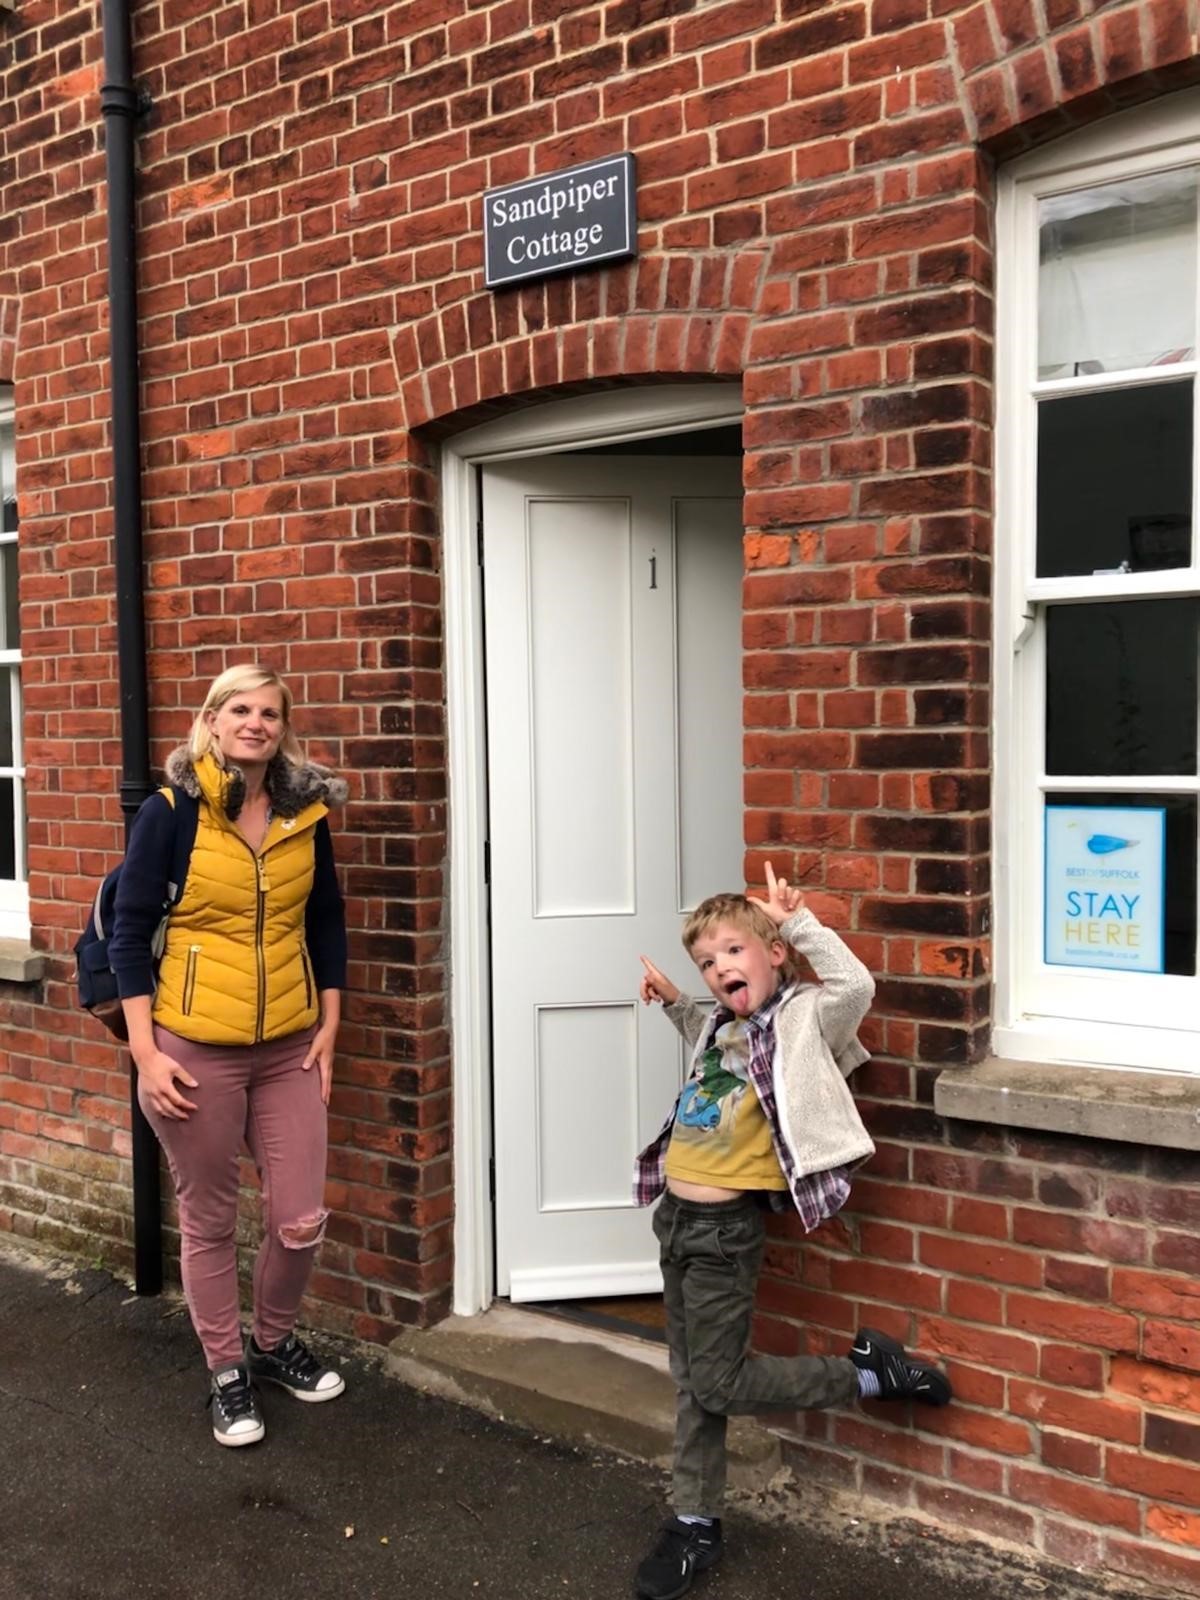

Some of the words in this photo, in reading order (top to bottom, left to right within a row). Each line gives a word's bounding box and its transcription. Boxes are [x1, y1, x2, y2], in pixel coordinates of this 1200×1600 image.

[492, 175, 619, 228] Sandpiper
[506, 223, 603, 265] Cottage
[1065, 890, 1141, 920] STAY
[1064, 920, 1141, 947] HERE
